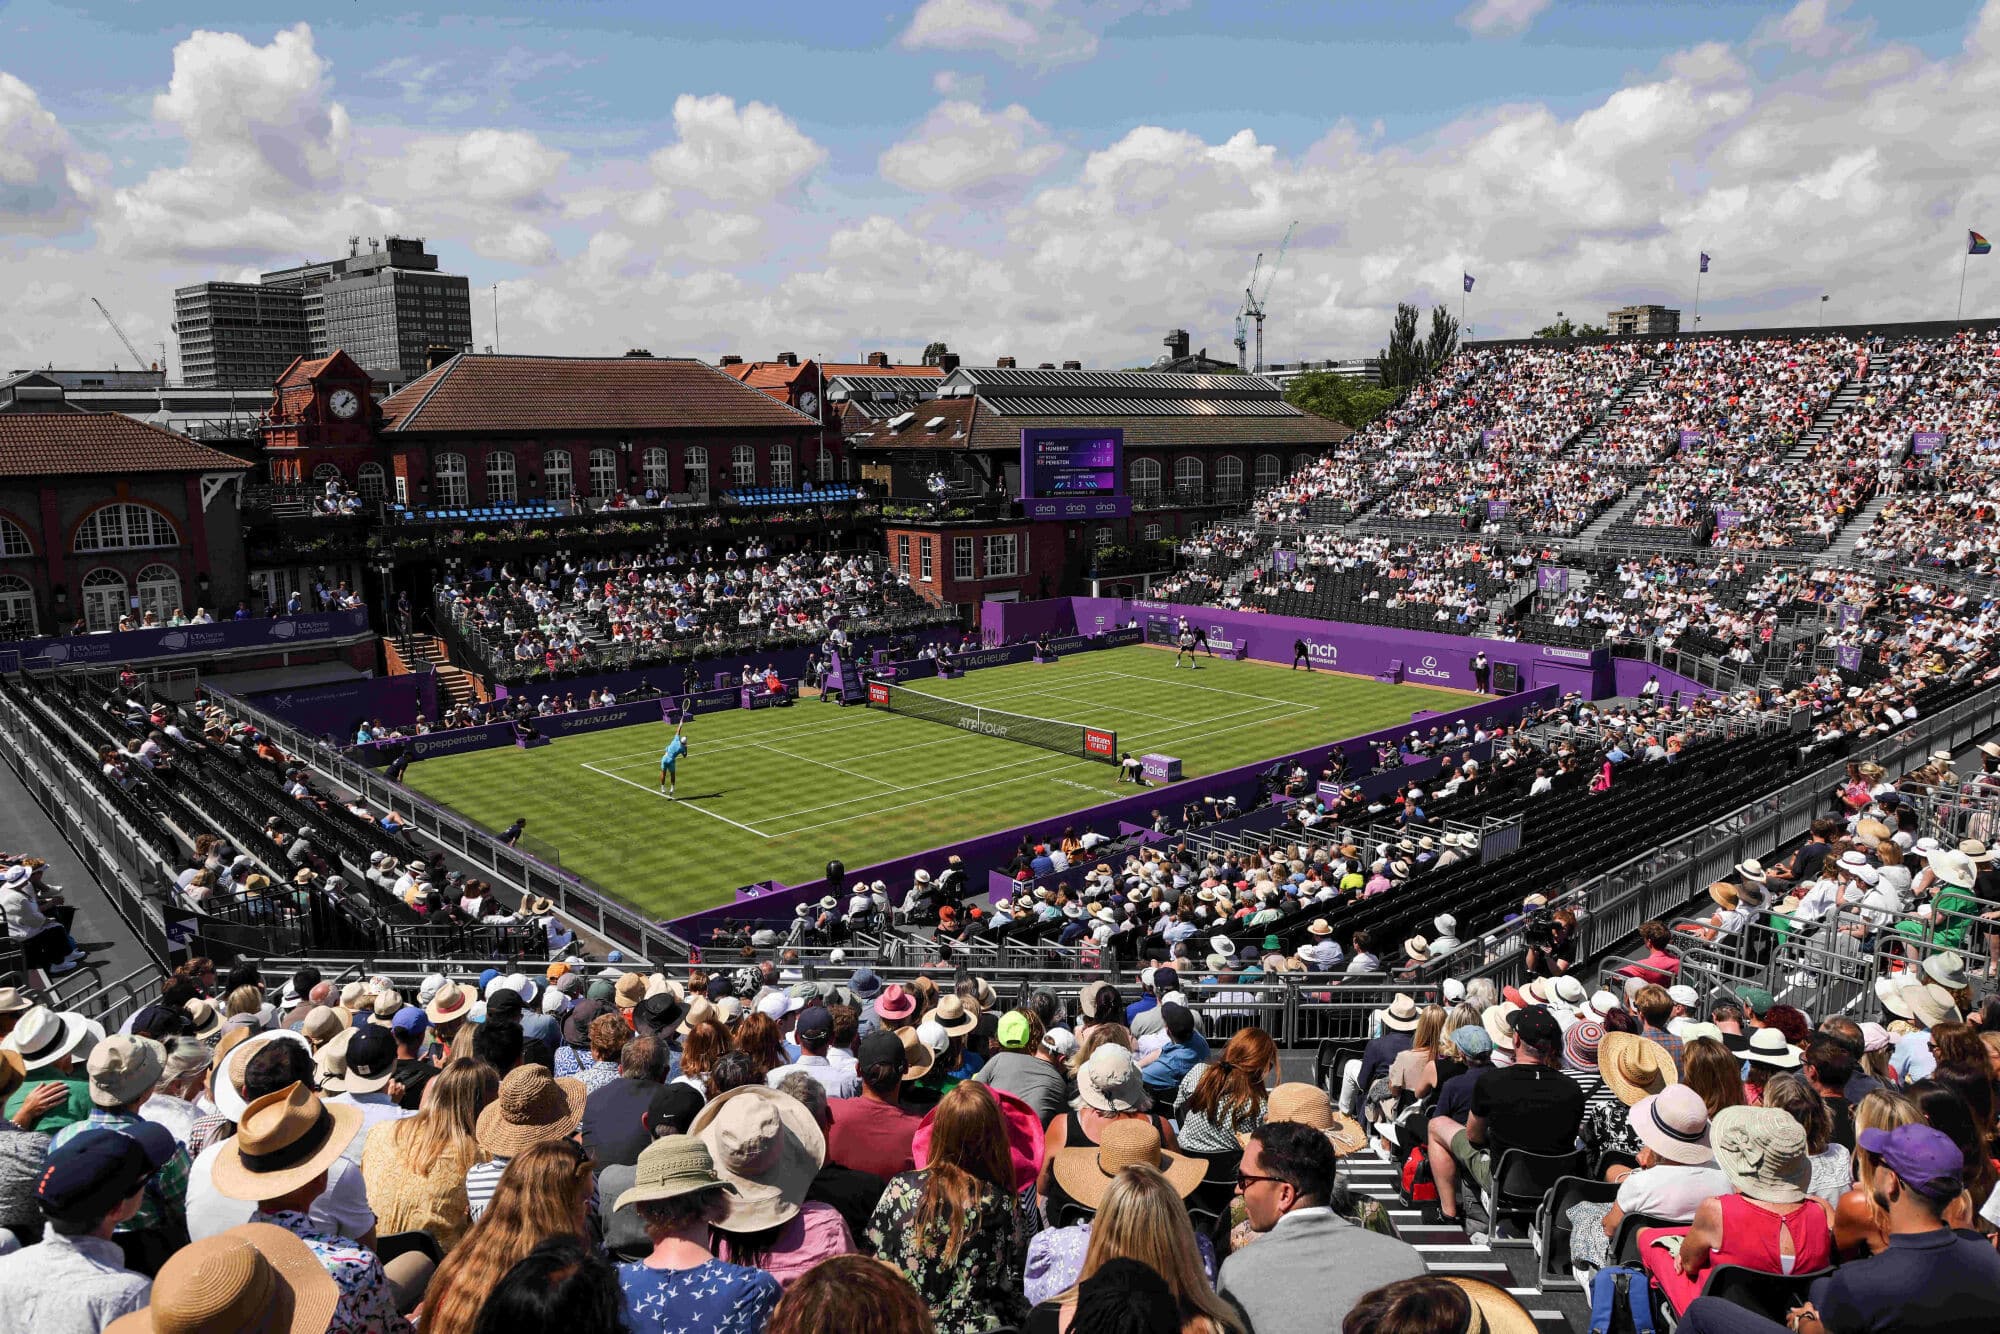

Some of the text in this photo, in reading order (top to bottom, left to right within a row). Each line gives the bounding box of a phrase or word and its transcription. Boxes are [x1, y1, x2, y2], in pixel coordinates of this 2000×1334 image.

[1035, 503, 1056, 513] cinch
[1066, 502, 1086, 512] cinch
[1095, 501, 1116, 511] cinch
[1303, 637, 1338, 659] inch
[1408, 666, 1450, 679] LEXUS
[571, 712, 628, 728] DUNLOP
[958, 717, 1008, 737] ATP TOUR
[429, 732, 488, 750] pepperstone
[1087, 734, 1111, 745] Emirates
[1142, 761, 1167, 778] Haier
